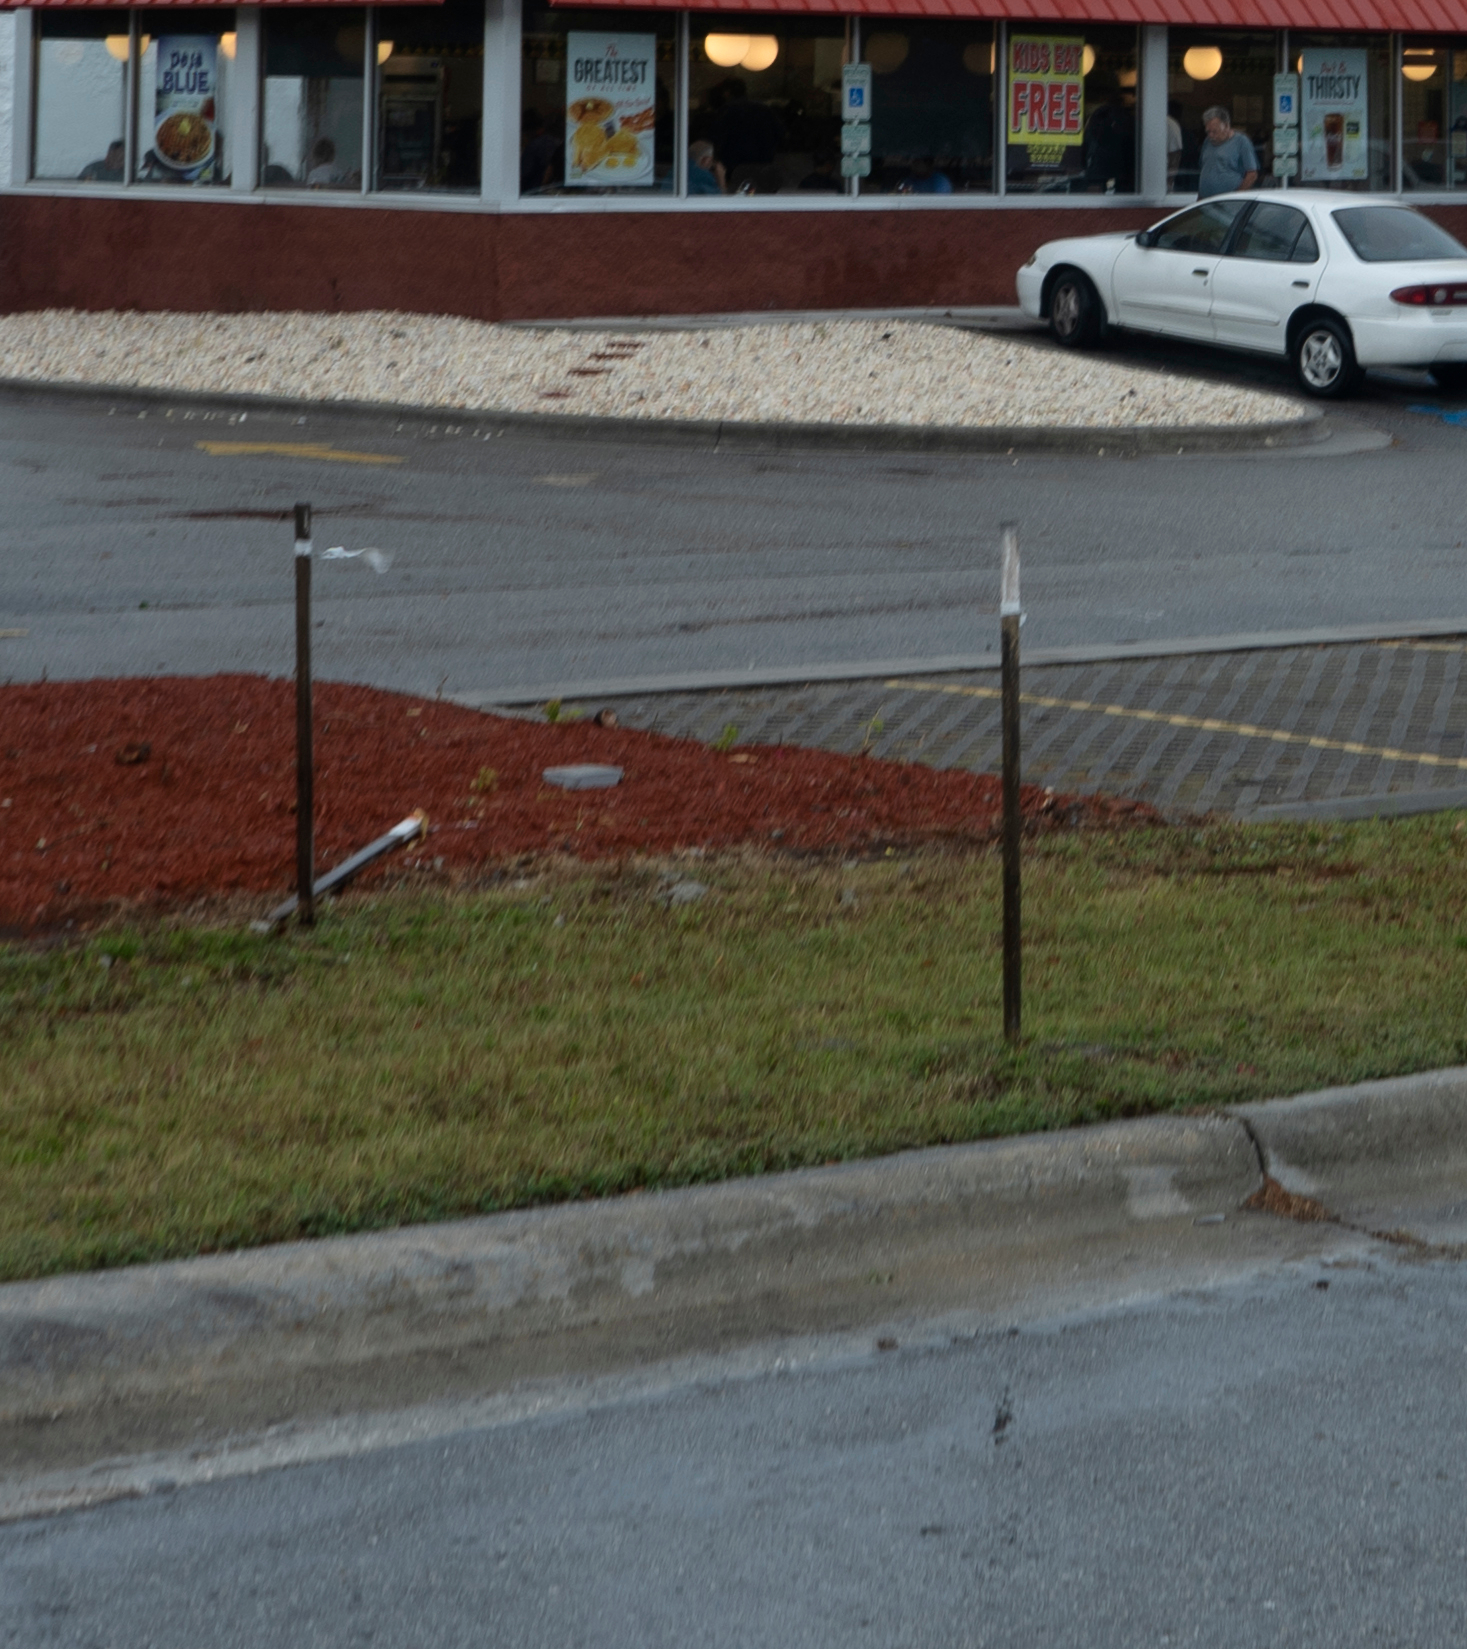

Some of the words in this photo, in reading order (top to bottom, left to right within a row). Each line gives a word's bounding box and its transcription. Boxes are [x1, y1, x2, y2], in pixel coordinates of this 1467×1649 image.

[575, 58, 648, 84] GREATEST
[1012, 42, 1050, 74] KIDS
[1053, 43, 1082, 75] EAT
[163, 71, 210, 95] BLUE
[1307, 75, 1361, 100] THIRSTY
[1011, 80, 1082, 135] FREE
